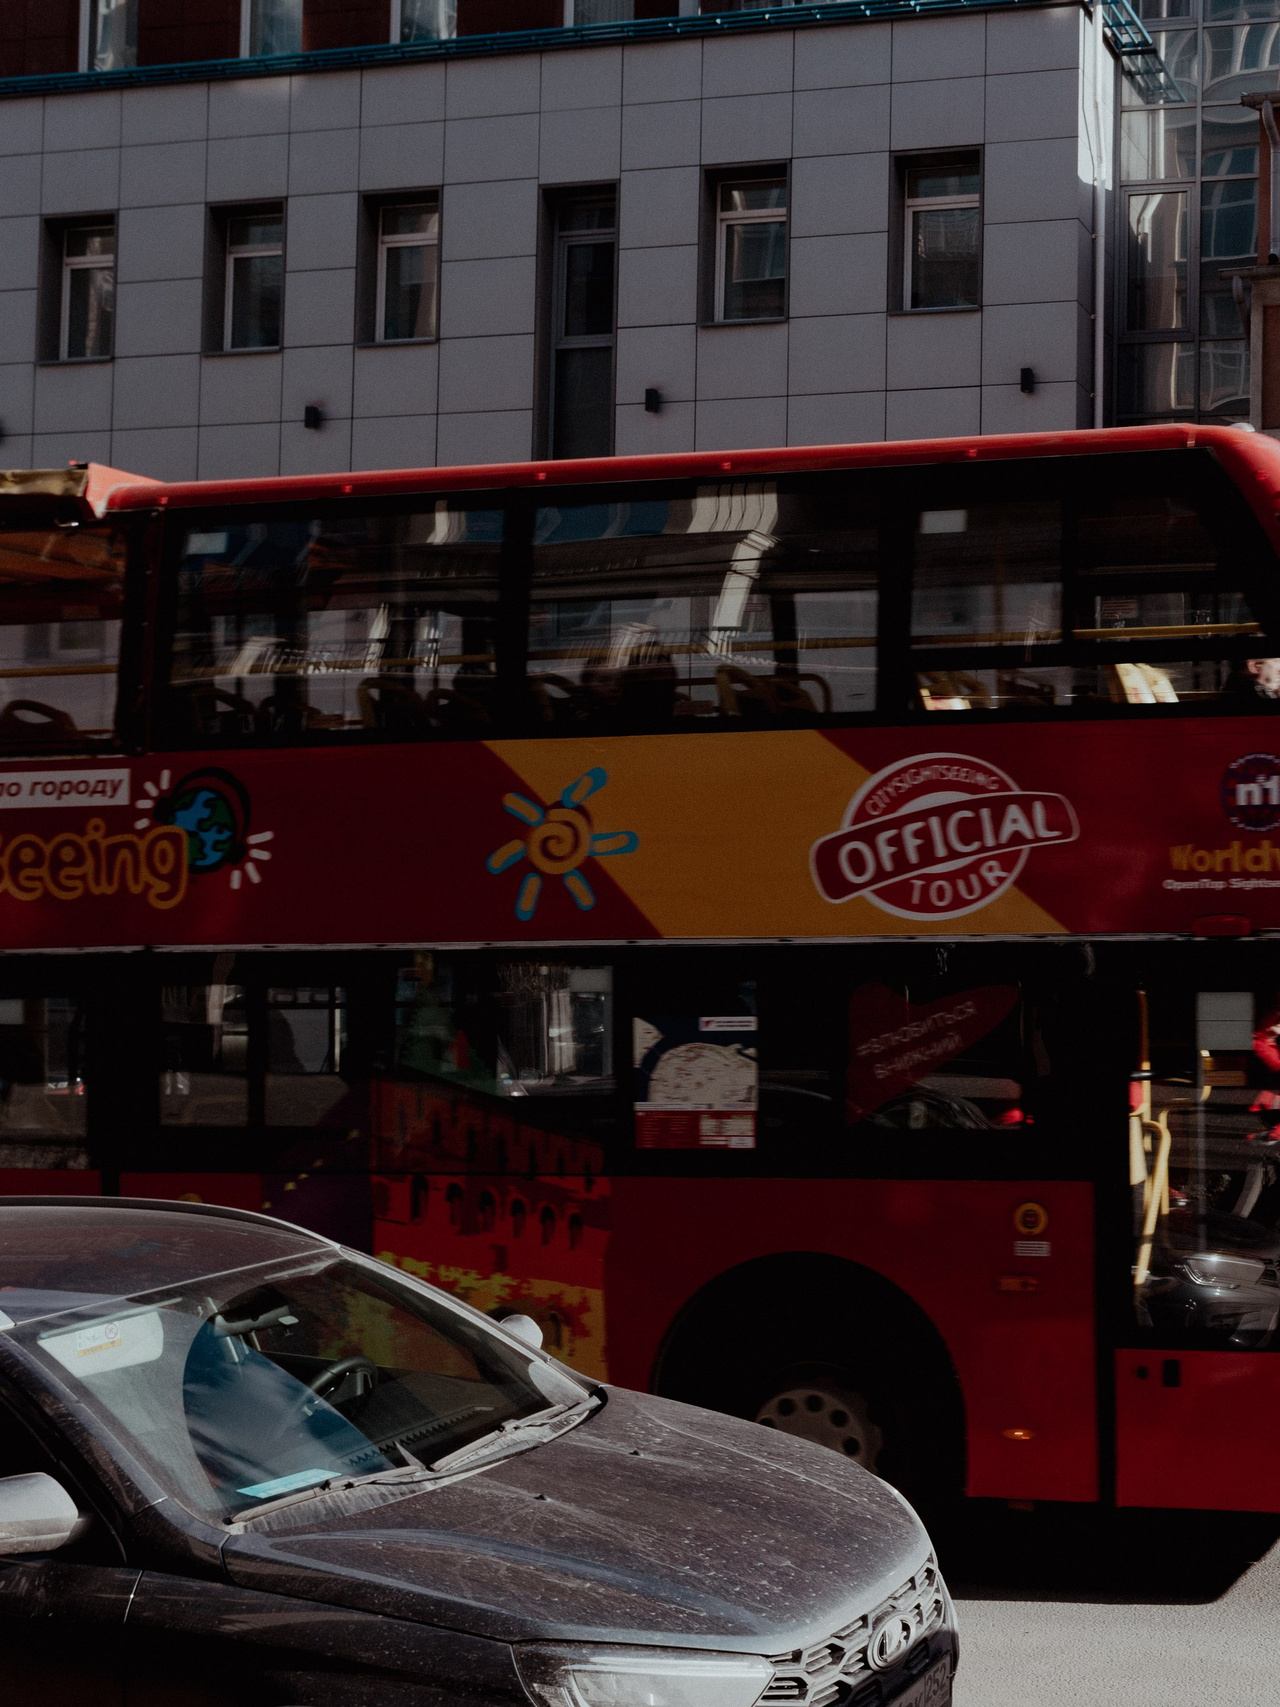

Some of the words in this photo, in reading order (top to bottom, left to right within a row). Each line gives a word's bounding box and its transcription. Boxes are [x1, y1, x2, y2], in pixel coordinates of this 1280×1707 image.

[0, 781, 21, 798] о
[30, 778, 123, 801] городу
[0, 817, 189, 911] eeing
[838, 800, 1063, 885] OFFICIAL
[909, 860, 1011, 907] TOUR
[925, 1661, 947, 1703] 252
